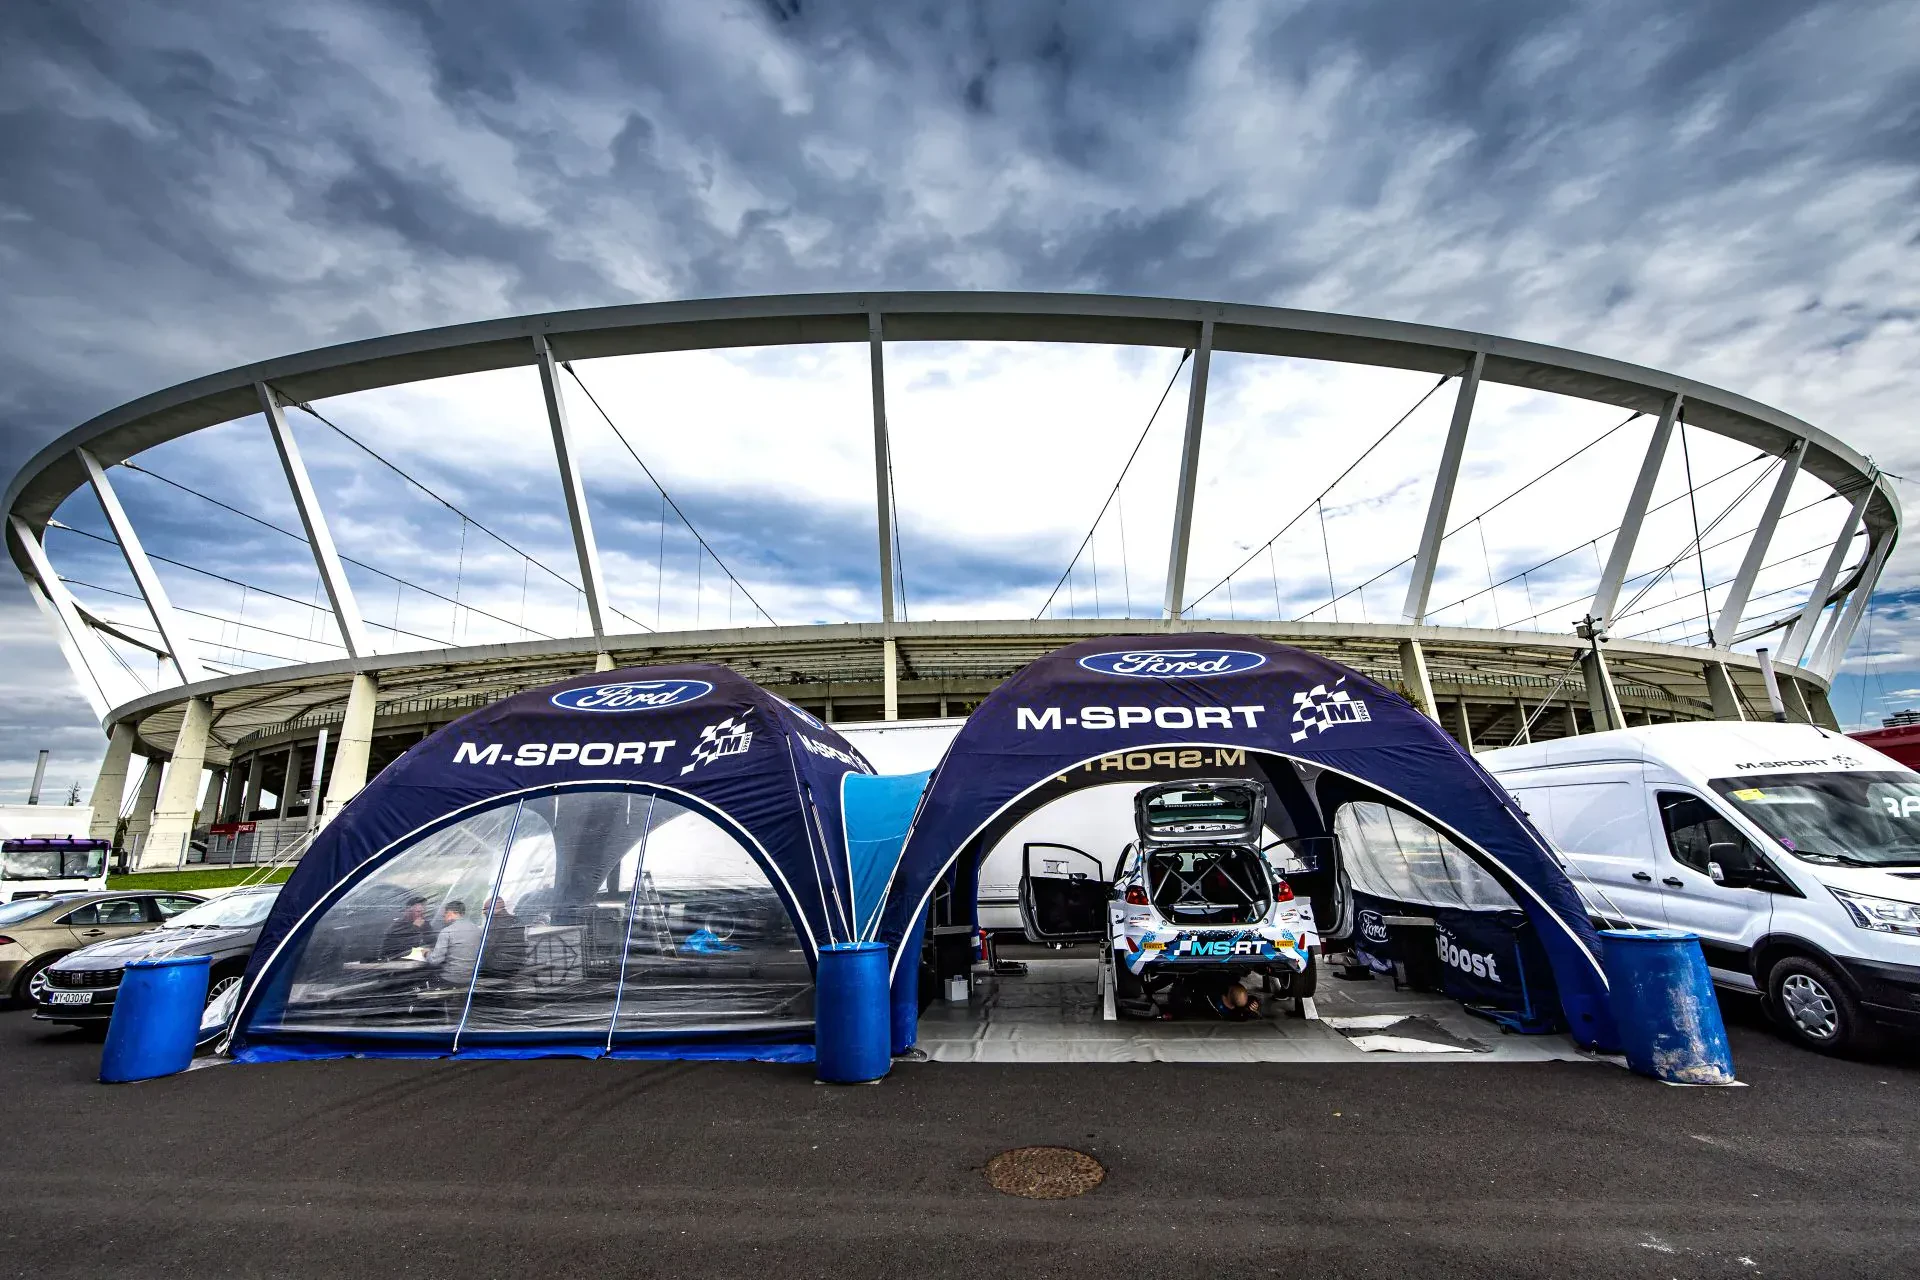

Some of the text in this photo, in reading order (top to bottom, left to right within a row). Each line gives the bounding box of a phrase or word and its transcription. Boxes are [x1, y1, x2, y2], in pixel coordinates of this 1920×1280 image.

[1112, 652, 1232, 673] Ford
[576, 683, 688, 707] Ford
[1017, 705, 1265, 730] M-SPORT
[452, 740, 676, 766] M-SPORT
[1735, 759, 1828, 770] M-SPORT
[1191, 940, 1268, 955] MS-RT
